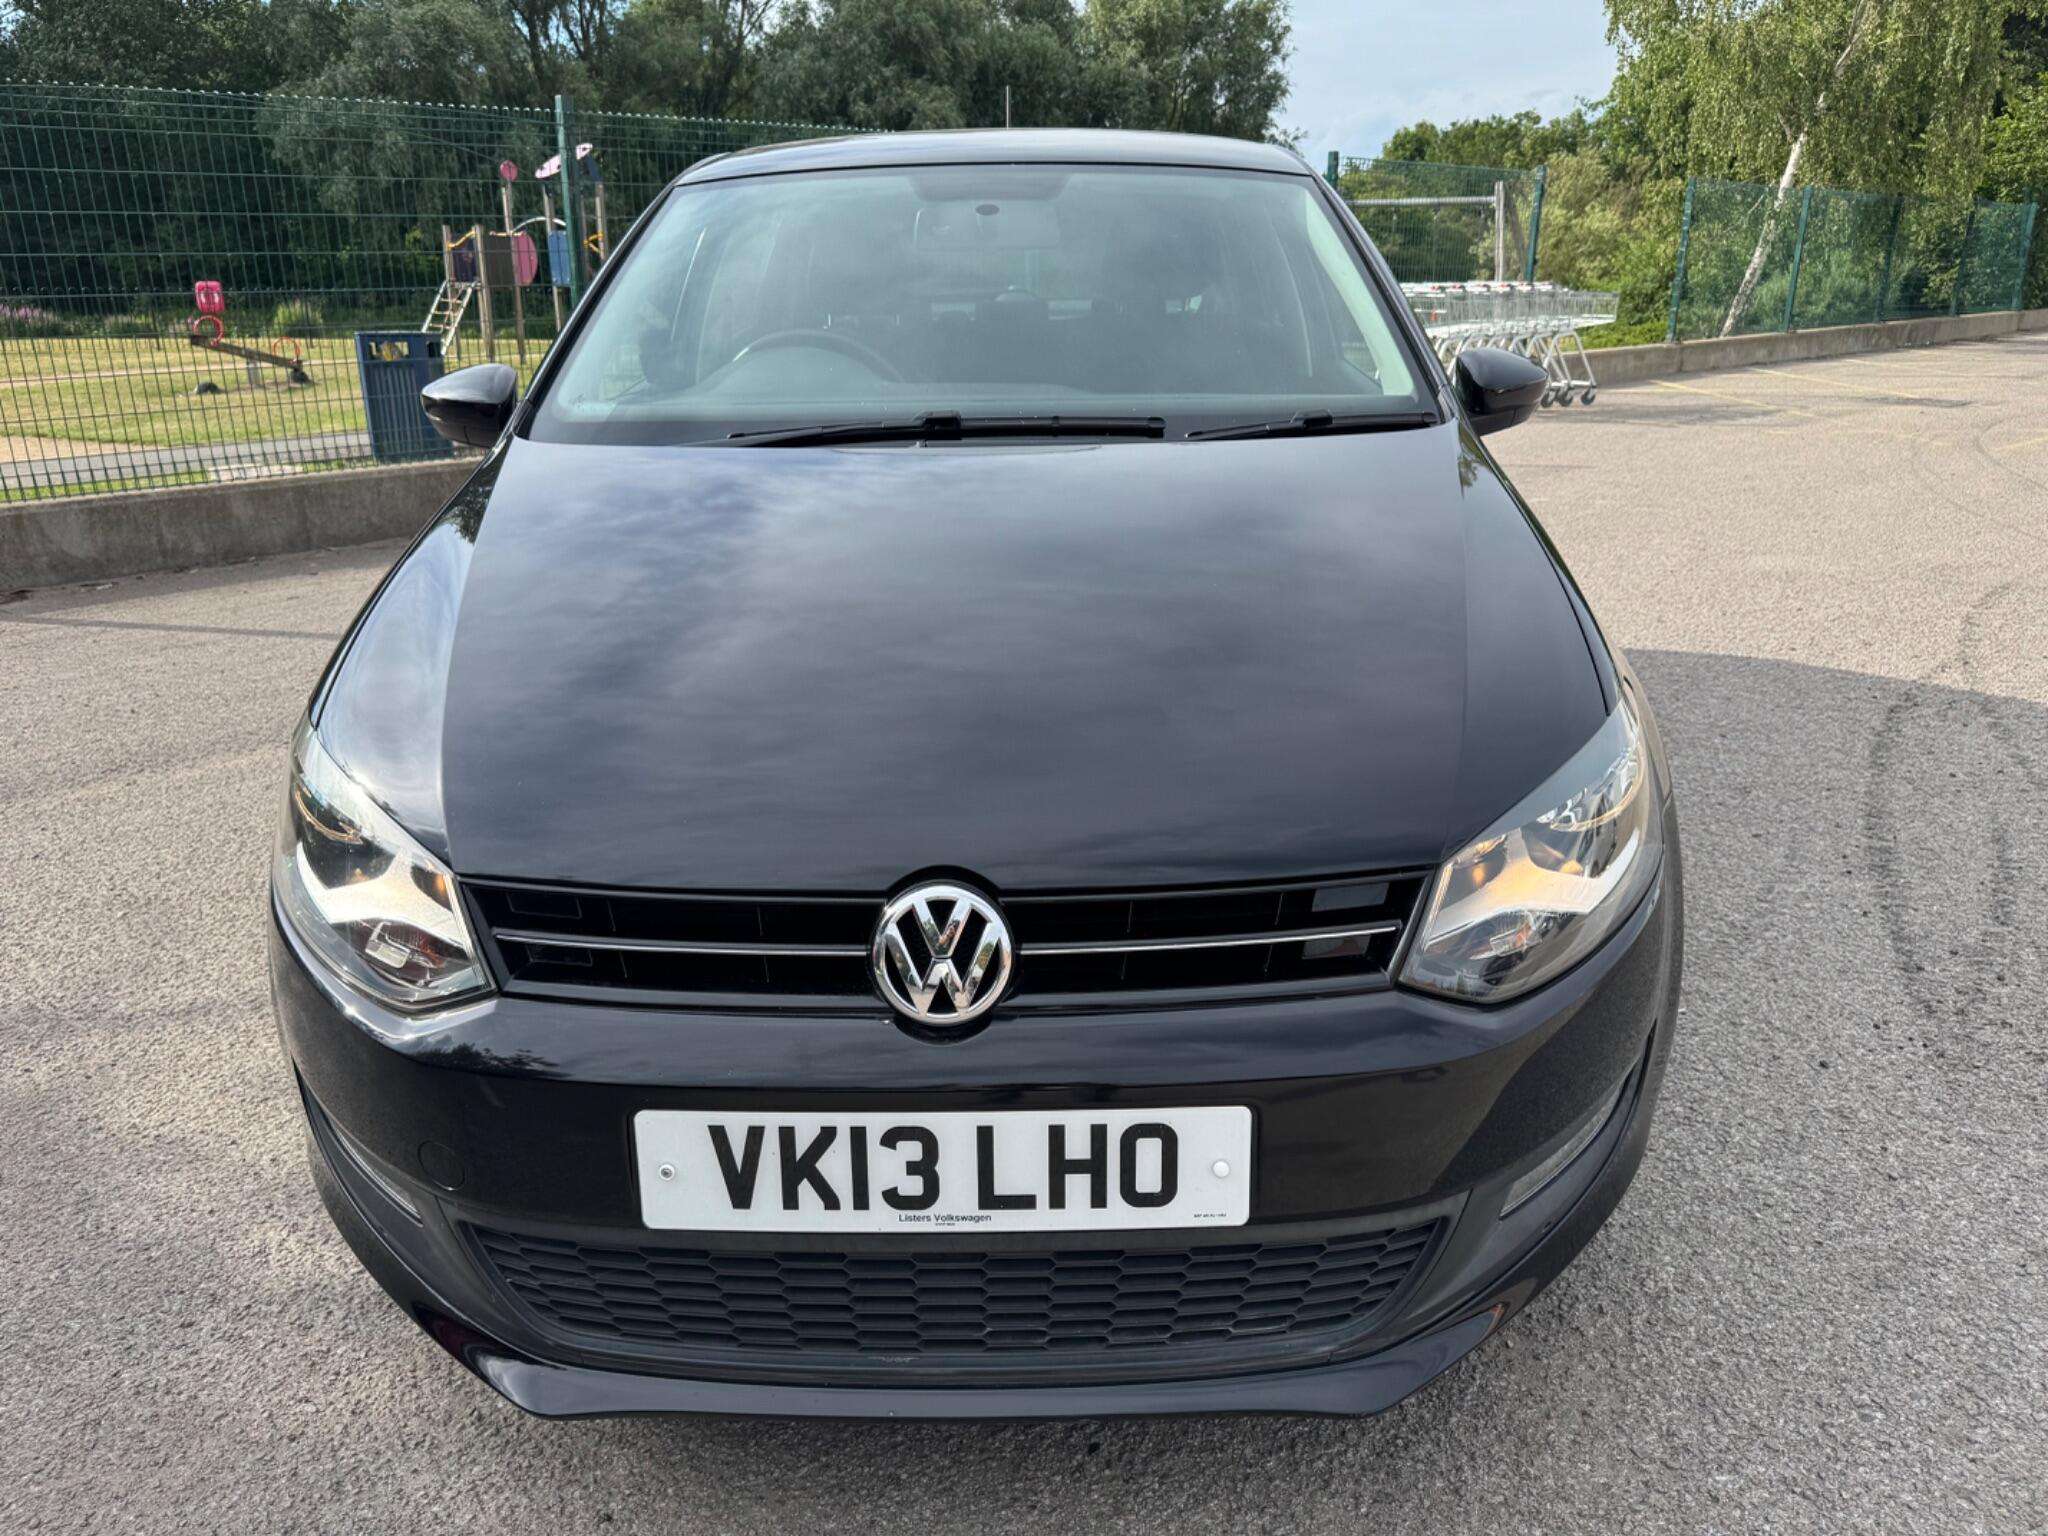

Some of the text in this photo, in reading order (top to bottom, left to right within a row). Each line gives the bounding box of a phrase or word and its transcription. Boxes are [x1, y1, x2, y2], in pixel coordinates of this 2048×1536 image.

[707, 1122, 1179, 1211] VK13 LHO
[898, 1214, 992, 1223] Listers Volkswagen
